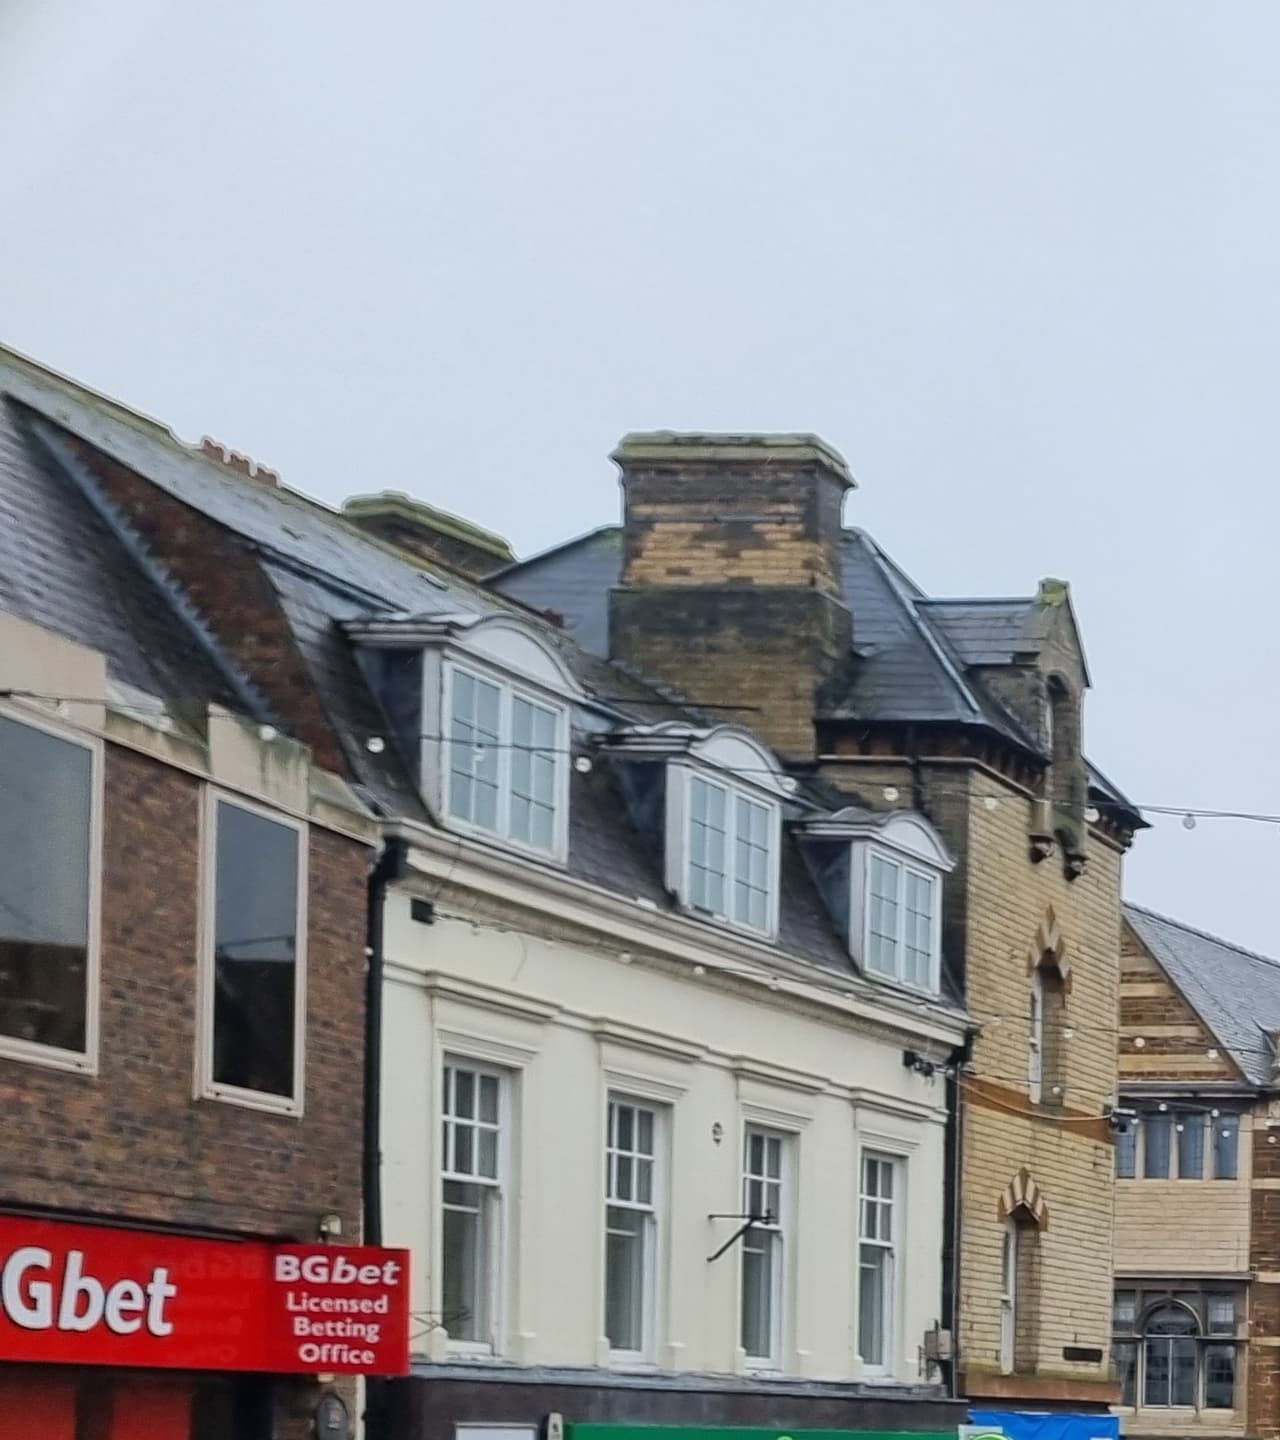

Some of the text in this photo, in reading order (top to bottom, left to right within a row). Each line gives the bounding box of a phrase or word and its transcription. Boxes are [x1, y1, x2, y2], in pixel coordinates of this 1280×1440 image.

[274, 1254, 401, 1286] BGbet
[286, 1291, 389, 1315] Licensed
[293, 1316, 380, 1343] Betting
[298, 1342, 375, 1365] Office
